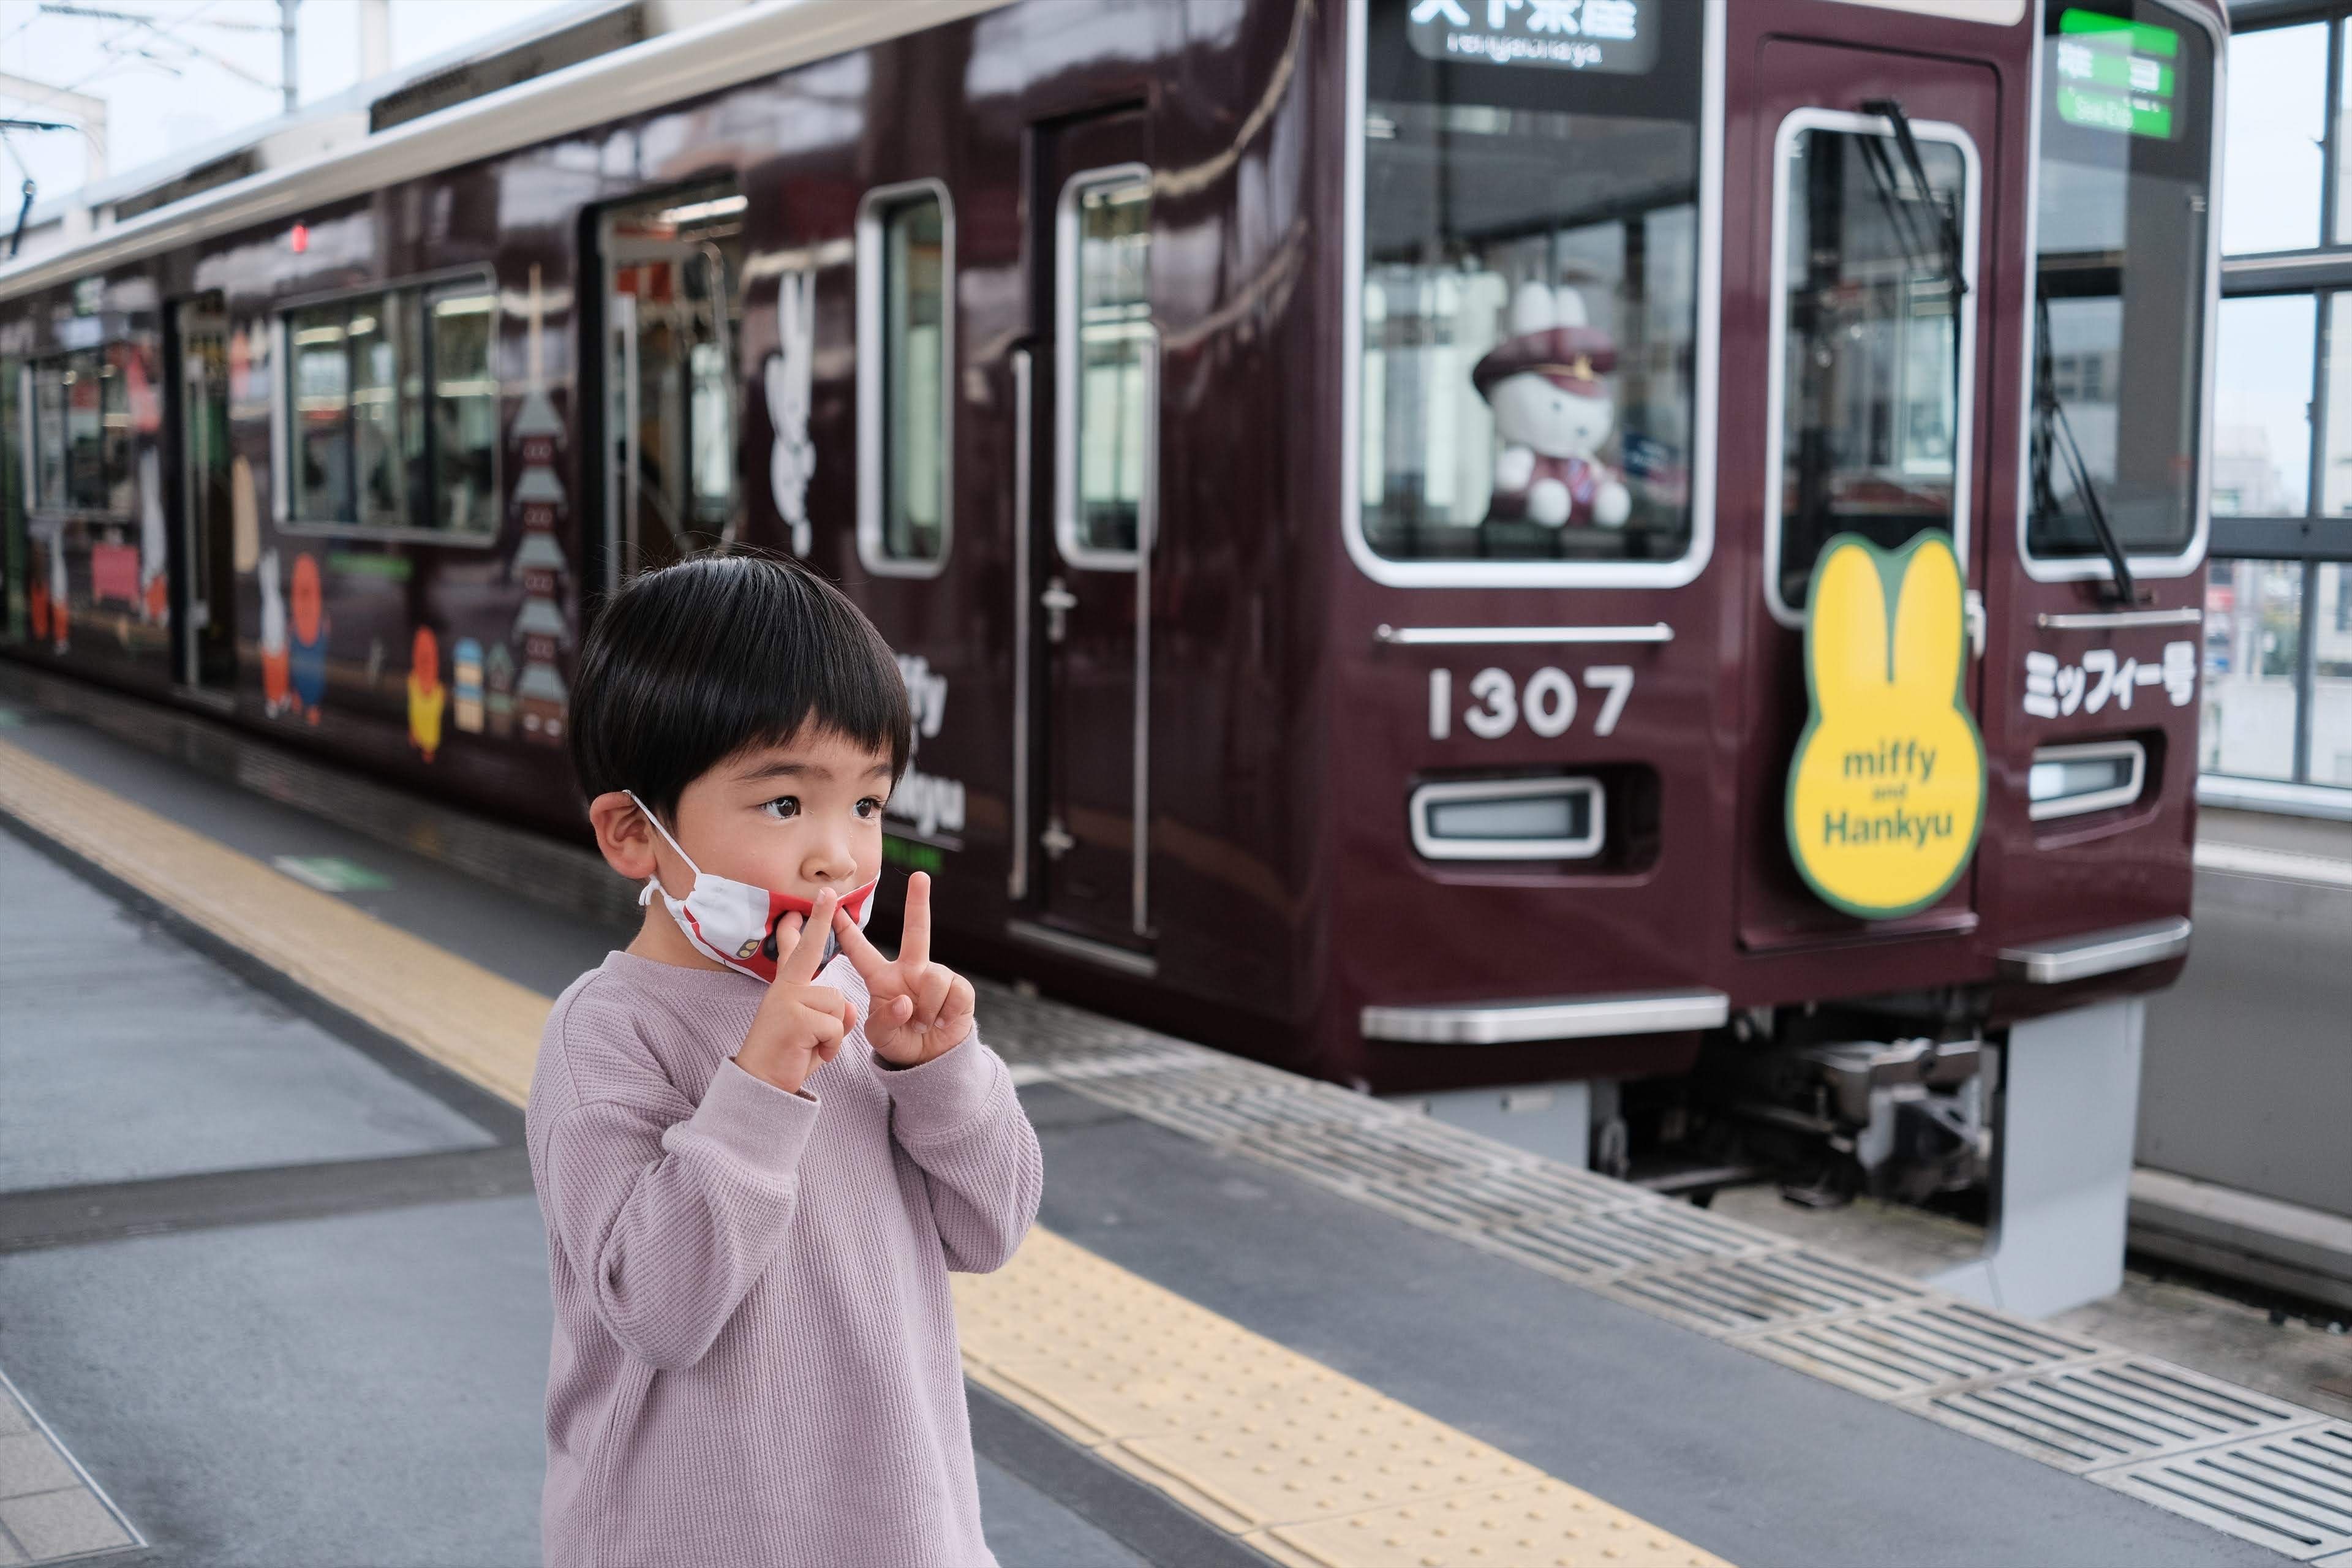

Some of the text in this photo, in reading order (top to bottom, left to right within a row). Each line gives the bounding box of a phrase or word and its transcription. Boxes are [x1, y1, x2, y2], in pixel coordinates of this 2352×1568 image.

[2023, 641, 2196, 719] ミッフィー号
[1428, 665, 1635, 741] 1307
[1843, 738, 1937, 783] miffy
[1872, 784, 1907, 801] and
[1823, 809, 1953, 850] Hankyu
